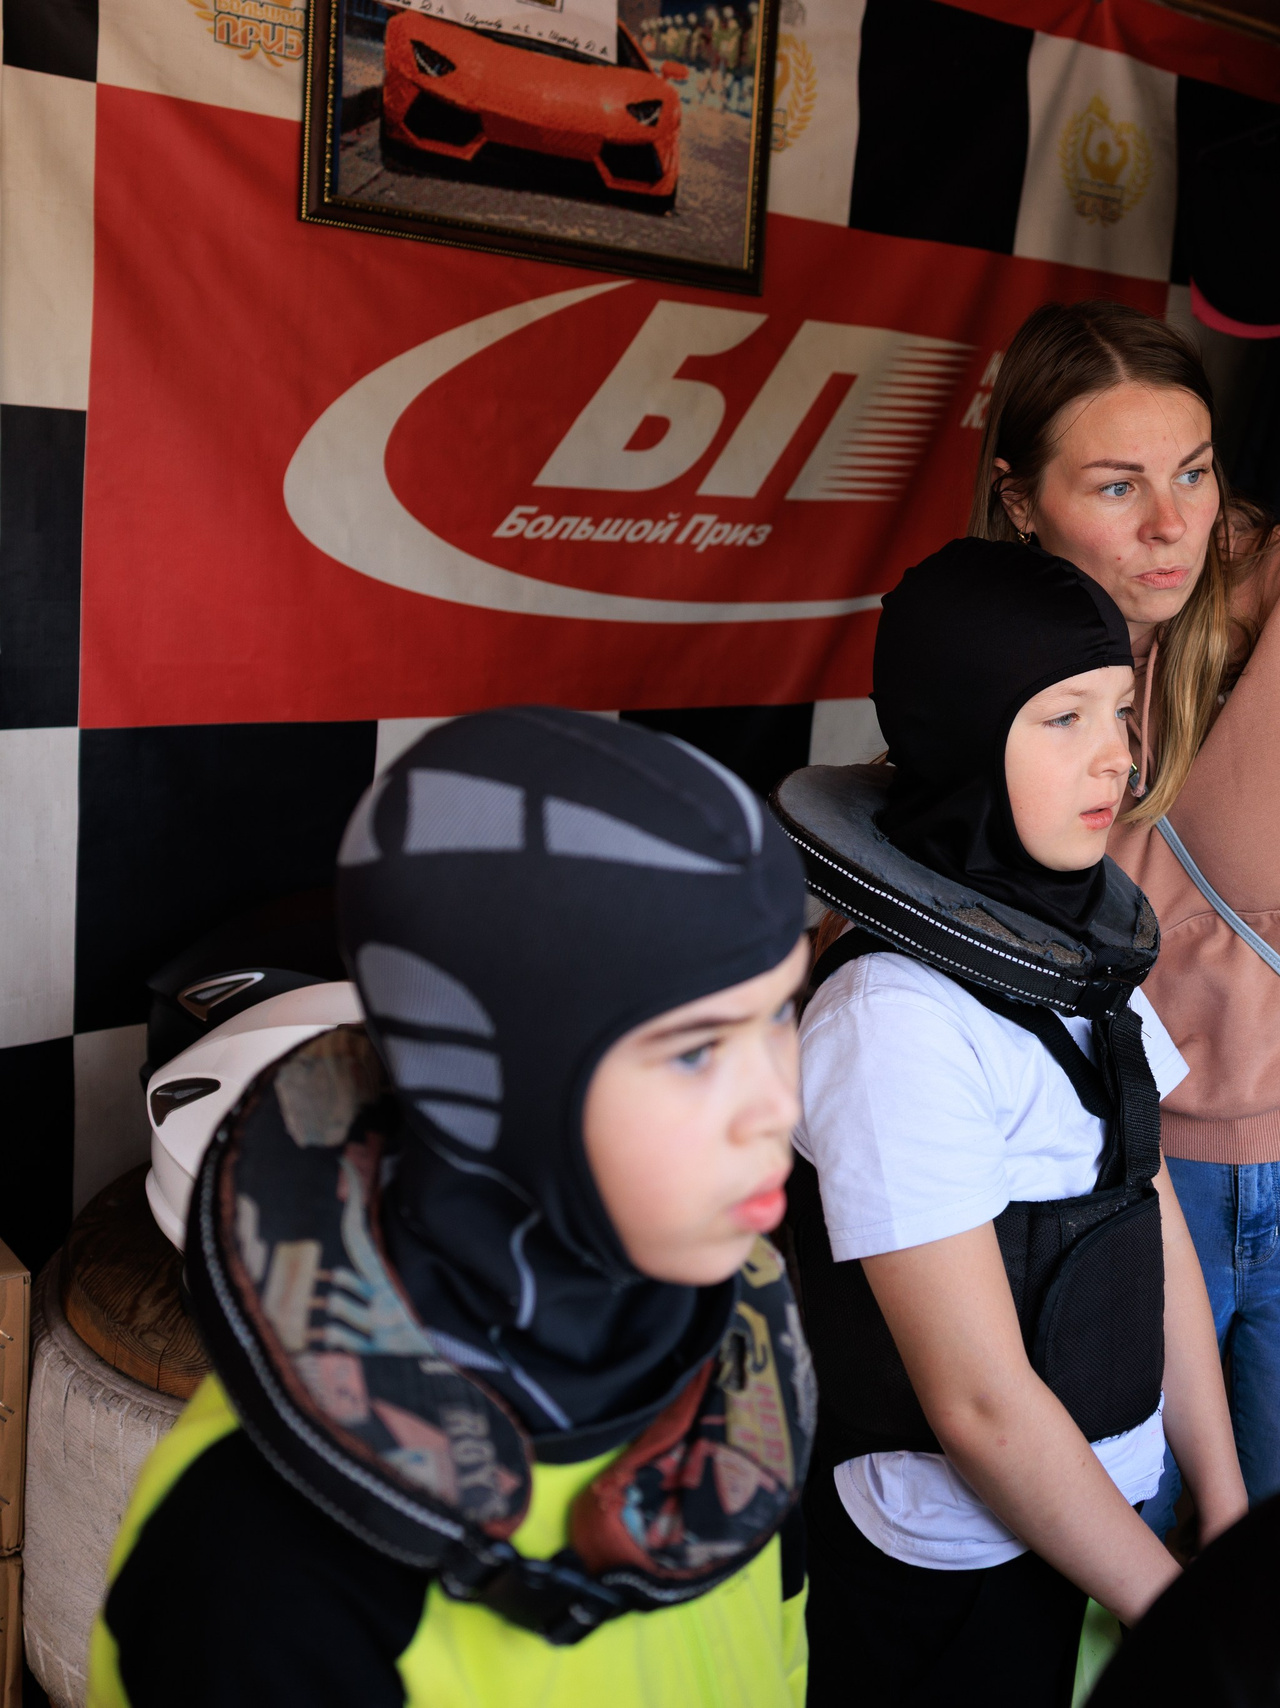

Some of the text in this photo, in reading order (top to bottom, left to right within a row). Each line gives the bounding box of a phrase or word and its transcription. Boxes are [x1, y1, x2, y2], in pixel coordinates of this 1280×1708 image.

[216, 14, 304, 58] ПРИЗ
[532, 299, 979, 502] БП
[493, 505, 773, 552] Большой Приз
